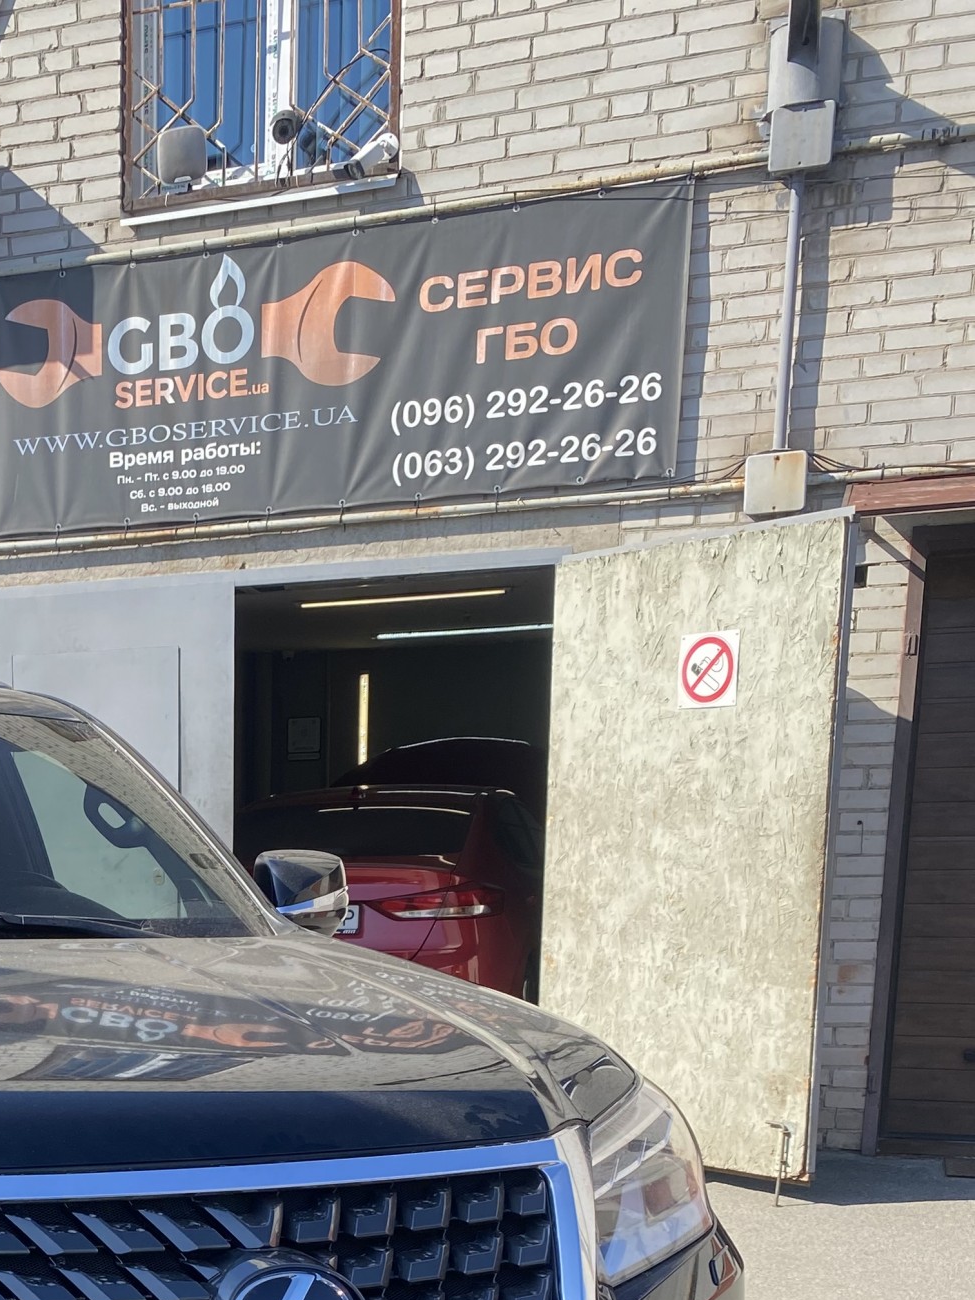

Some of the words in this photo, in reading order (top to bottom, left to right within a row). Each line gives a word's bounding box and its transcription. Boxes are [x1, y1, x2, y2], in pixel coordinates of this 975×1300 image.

[419, 248, 643, 313] СЕРВИС
[107, 302, 255, 376] GBO
[476, 316, 579, 364] ГБО
[391, 394, 475, 436] (096)
[486, 372, 663, 419] 292-26-26
[13, 405, 359, 457] WWW.GBOSERVICE.UA
[109, 450, 174, 470] Время
[181, 441, 261, 465] работы:
[171, 469, 197, 479] 9.00
[392, 446, 475, 487] (063)
[485, 427, 658, 471] 292-26-26
[158, 486, 183, 497] 9.00
[167, 497, 219, 511] выходной
